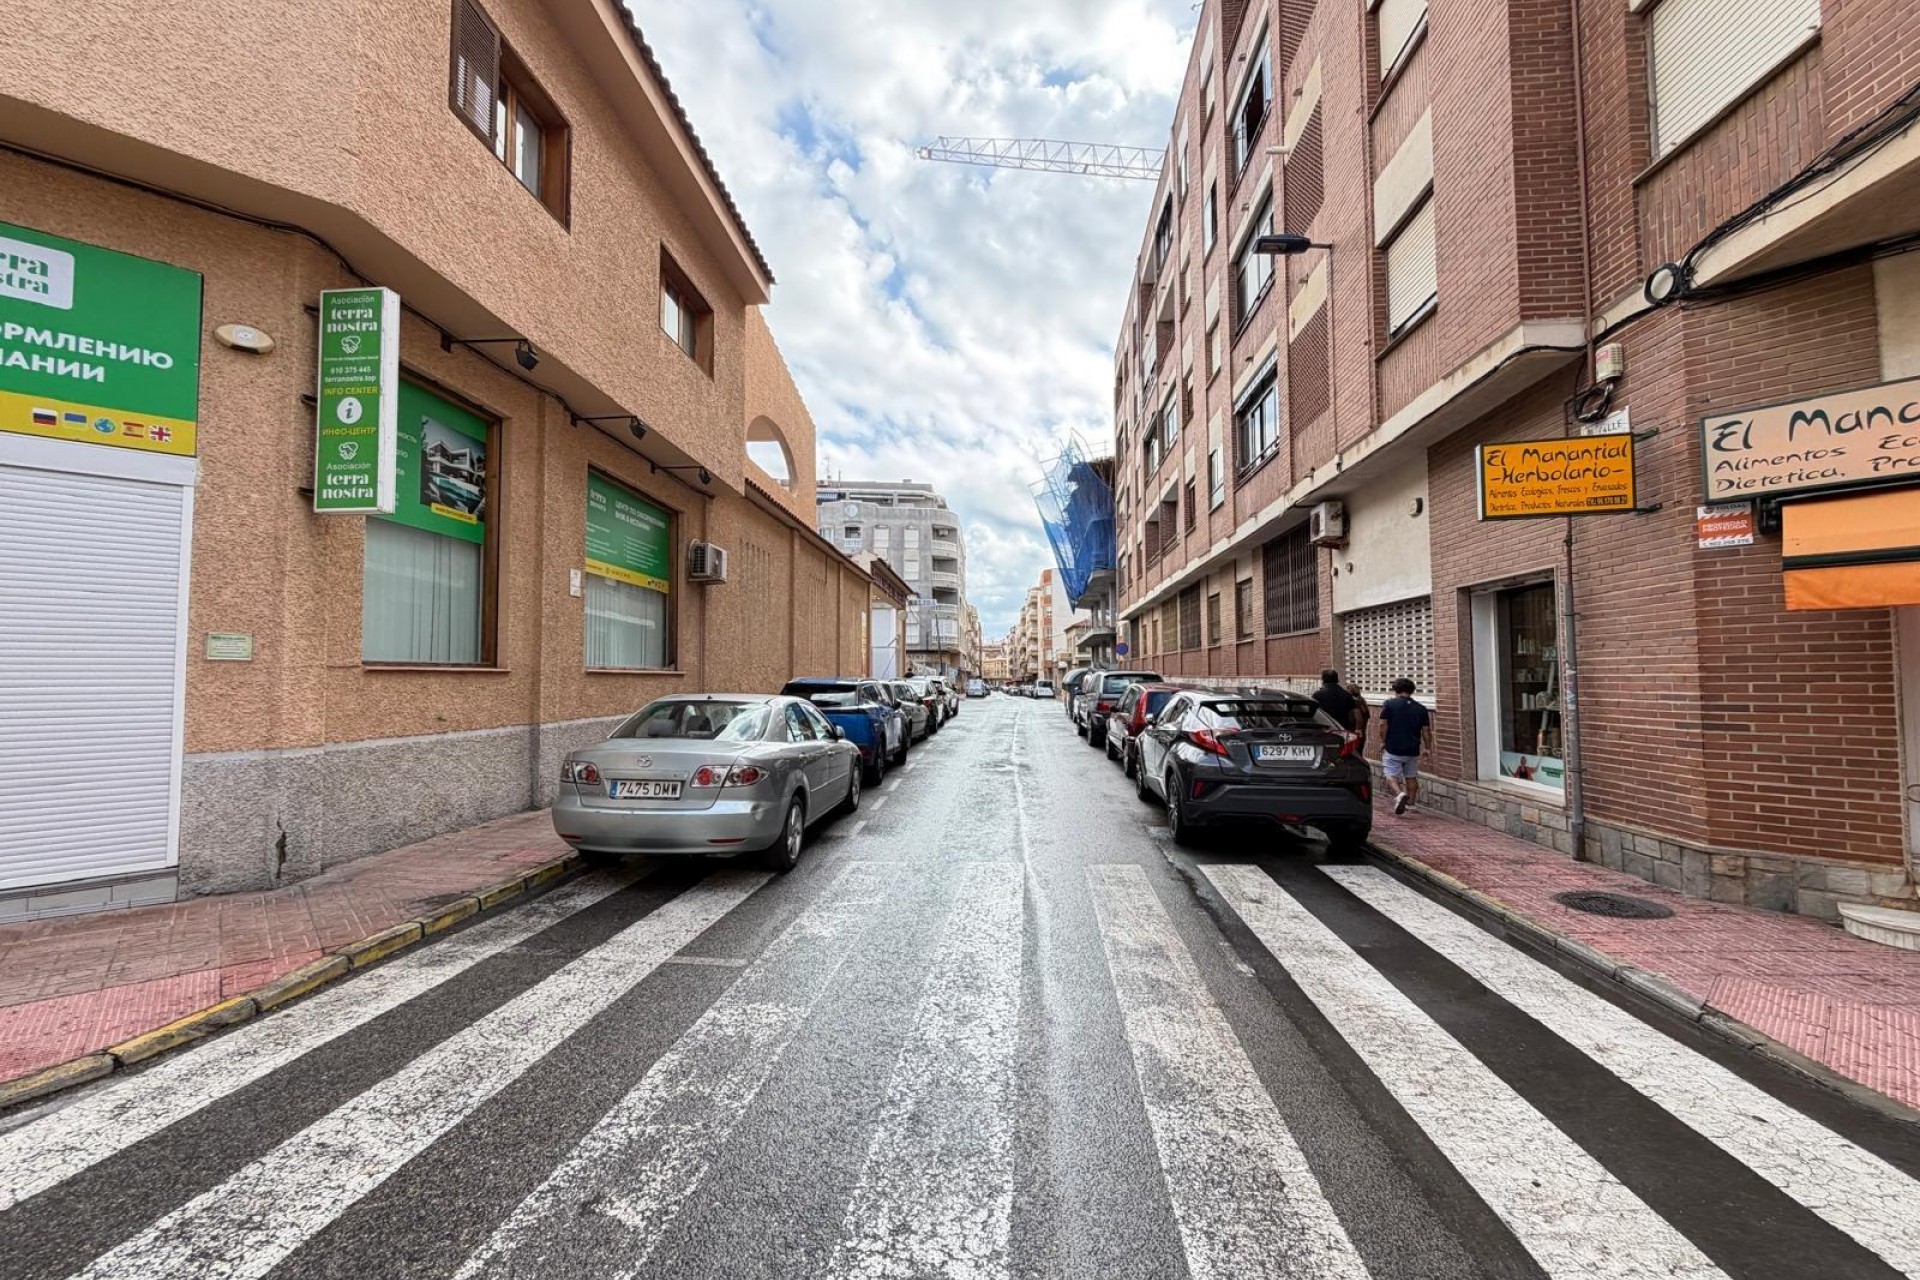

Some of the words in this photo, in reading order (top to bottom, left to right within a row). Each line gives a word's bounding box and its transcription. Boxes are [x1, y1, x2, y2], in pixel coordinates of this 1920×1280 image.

[331, 308, 373, 320] terra
[327, 321, 378, 333] nostra
[0, 322, 173, 369] РМЛЕНИЮ
[324, 387, 344, 396] INFO
[345, 386, 378, 395] CENTER
[322, 427, 377, 436] ИНФО-ЦЕНТР
[1711, 419, 1754, 452] El
[1487, 450, 1505, 466] El
[1522, 441, 1627, 465] Manantial
[1714, 446, 1848, 473] Alimentos
[1879, 434, 1920, 449] Ec
[326, 473, 369, 486] terra
[322, 487, 374, 499] nostra
[1262, 746, 1288, 756] 6297
[1291, 746, 1311, 756] KHY
[619, 782, 650, 795] 7475
[653, 783, 679, 796] DMW
